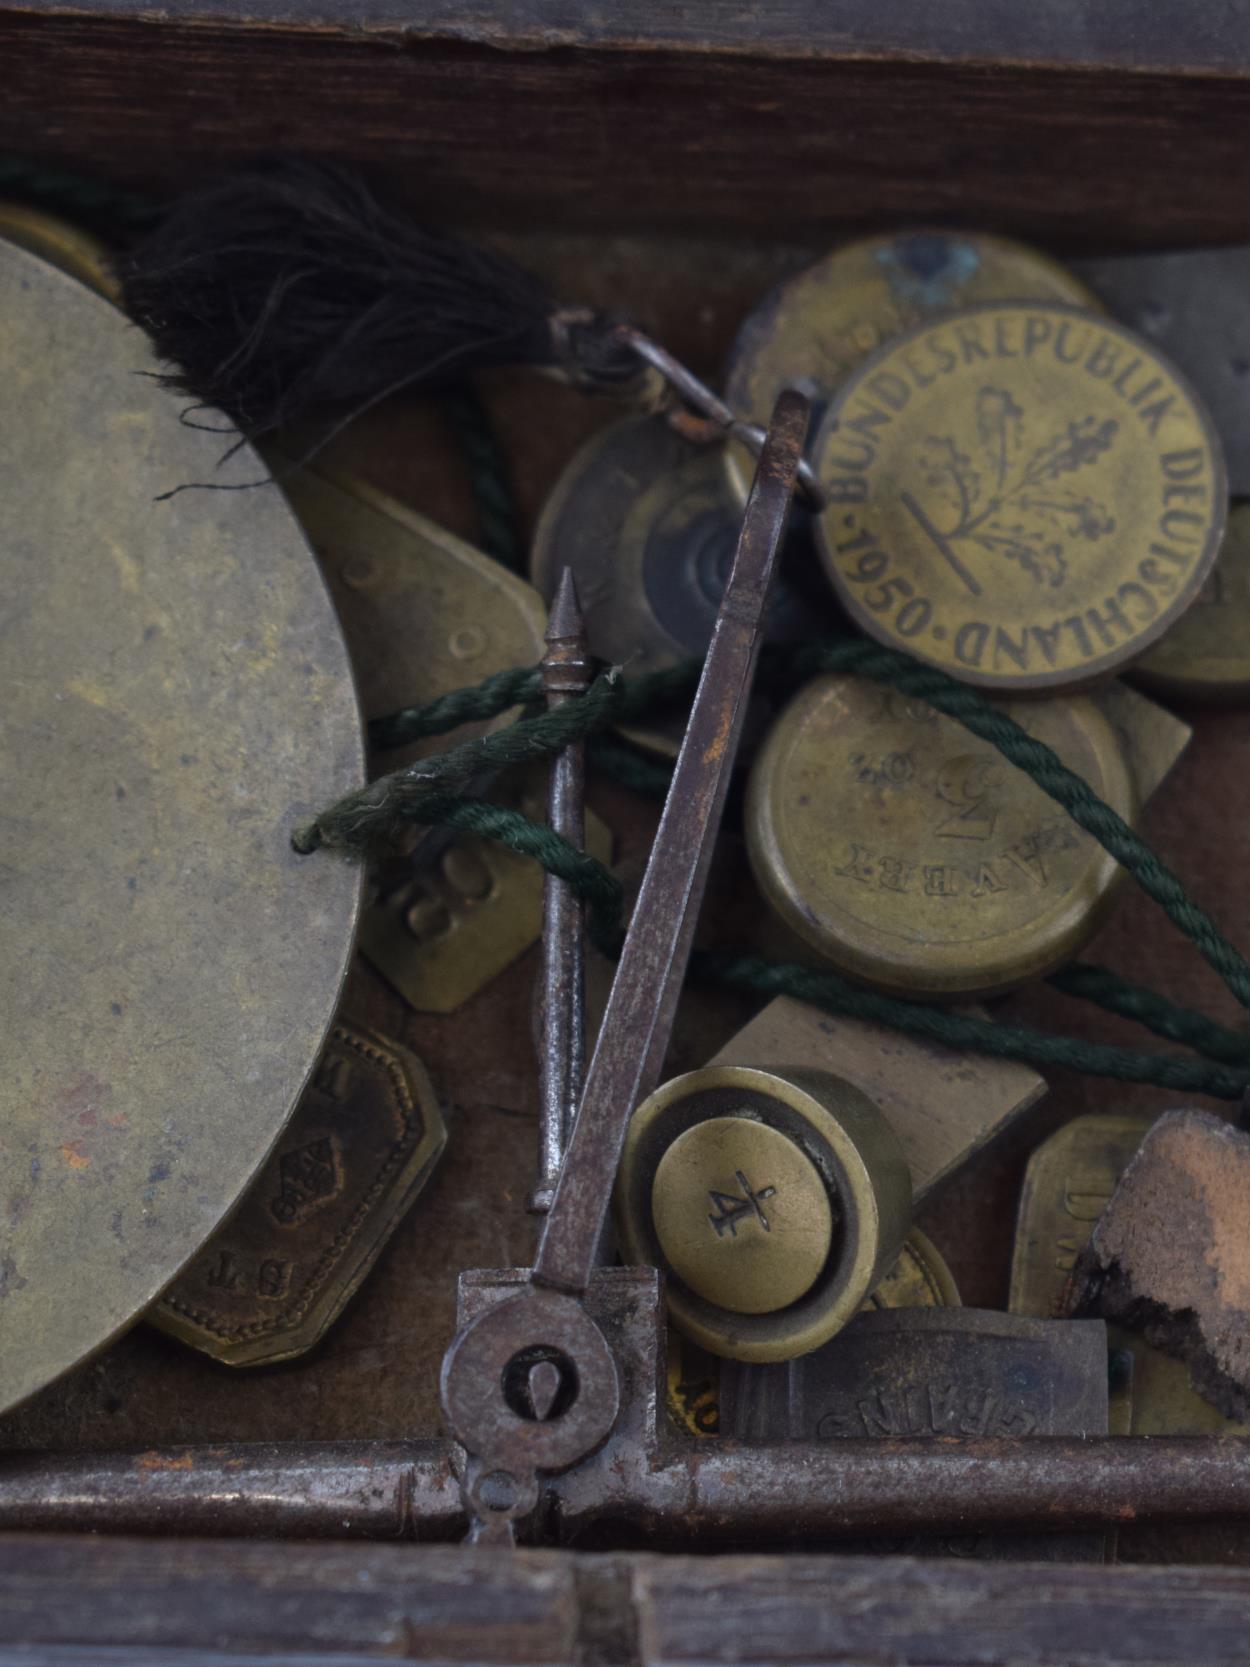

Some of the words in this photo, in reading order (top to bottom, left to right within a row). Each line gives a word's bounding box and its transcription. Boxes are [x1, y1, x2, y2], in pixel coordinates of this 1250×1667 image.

[826, 314, 1186, 504] BUNDESREPUBLIK
[834, 525, 933, 638] 1950
[954, 446, 1208, 671] DEUTSCHLAND
[833, 832, 1050, 898] AVERY
